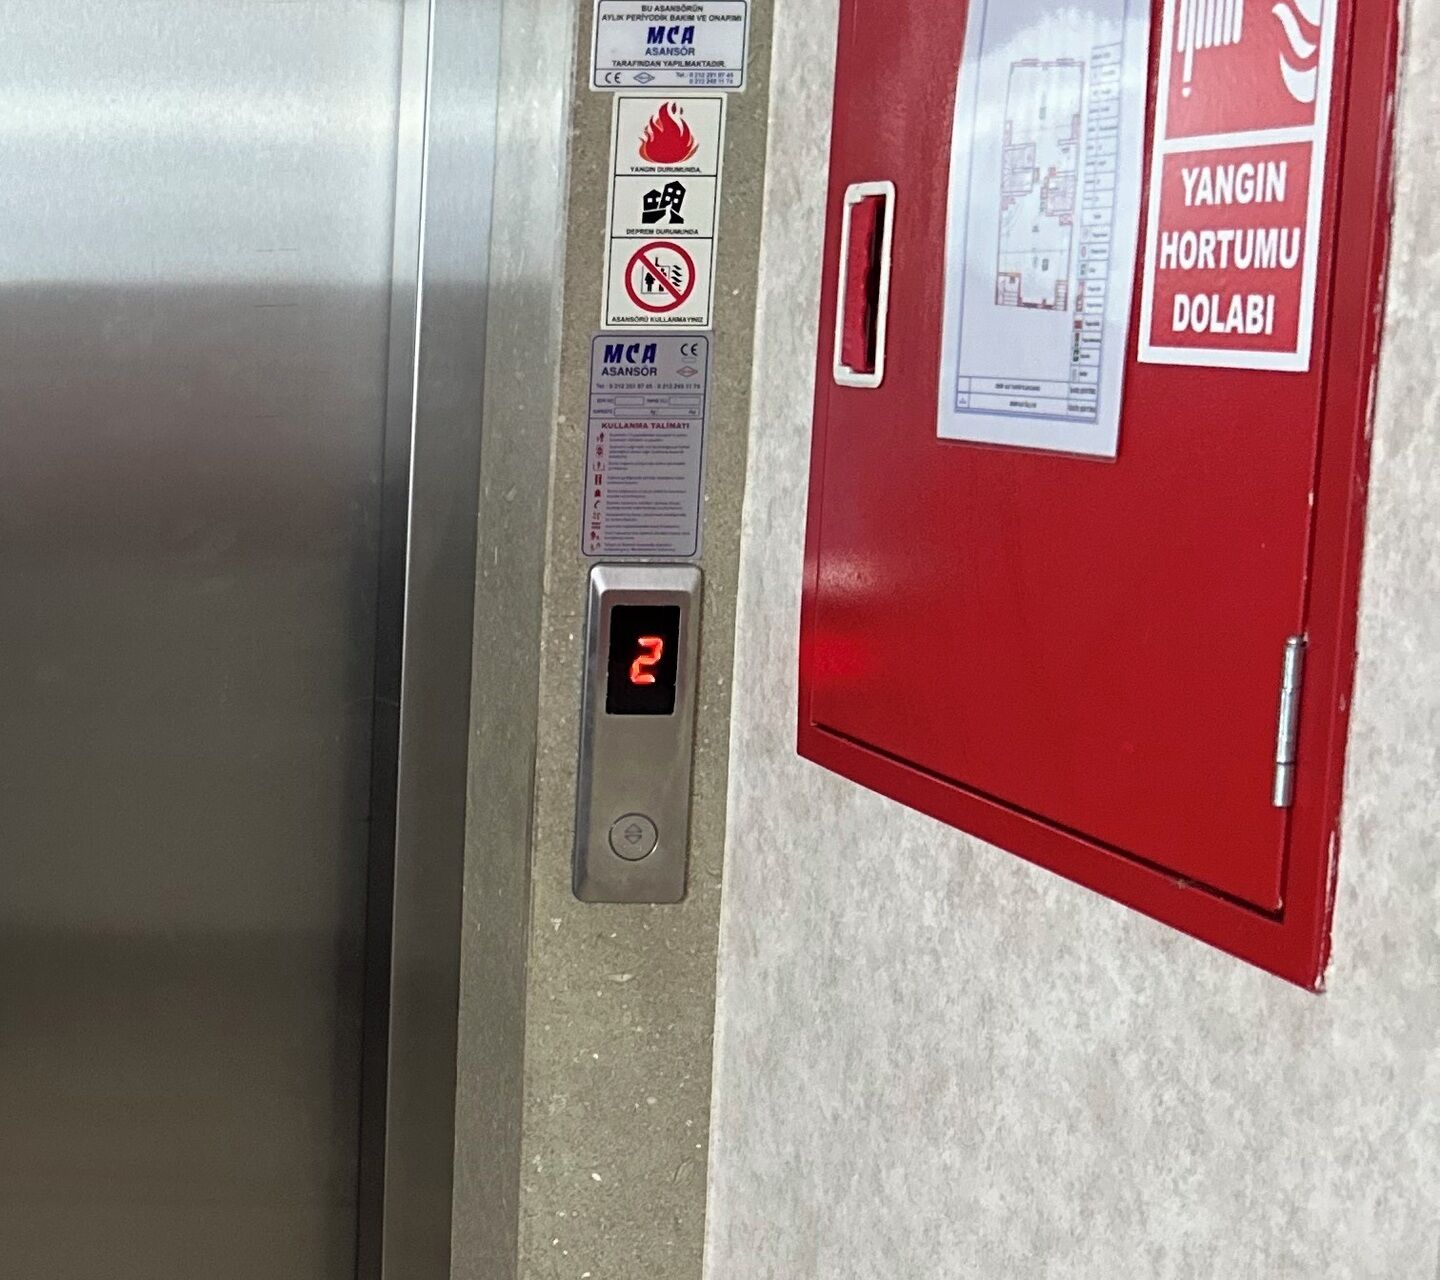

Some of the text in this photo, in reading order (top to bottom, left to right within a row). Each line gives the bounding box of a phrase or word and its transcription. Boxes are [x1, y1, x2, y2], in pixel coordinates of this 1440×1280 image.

[645, 46, 696, 56] ASANSÖR
[647, 25, 695, 45] MCA
[1181, 160, 1287, 207] YANGIN
[1160, 227, 1301, 272] HORTUMU
[1172, 293, 1276, 335] DOLABI
[603, 342, 657, 364] MCA
[601, 364, 658, 377] ASANSÖR
[630, 636, 664, 685] 2
